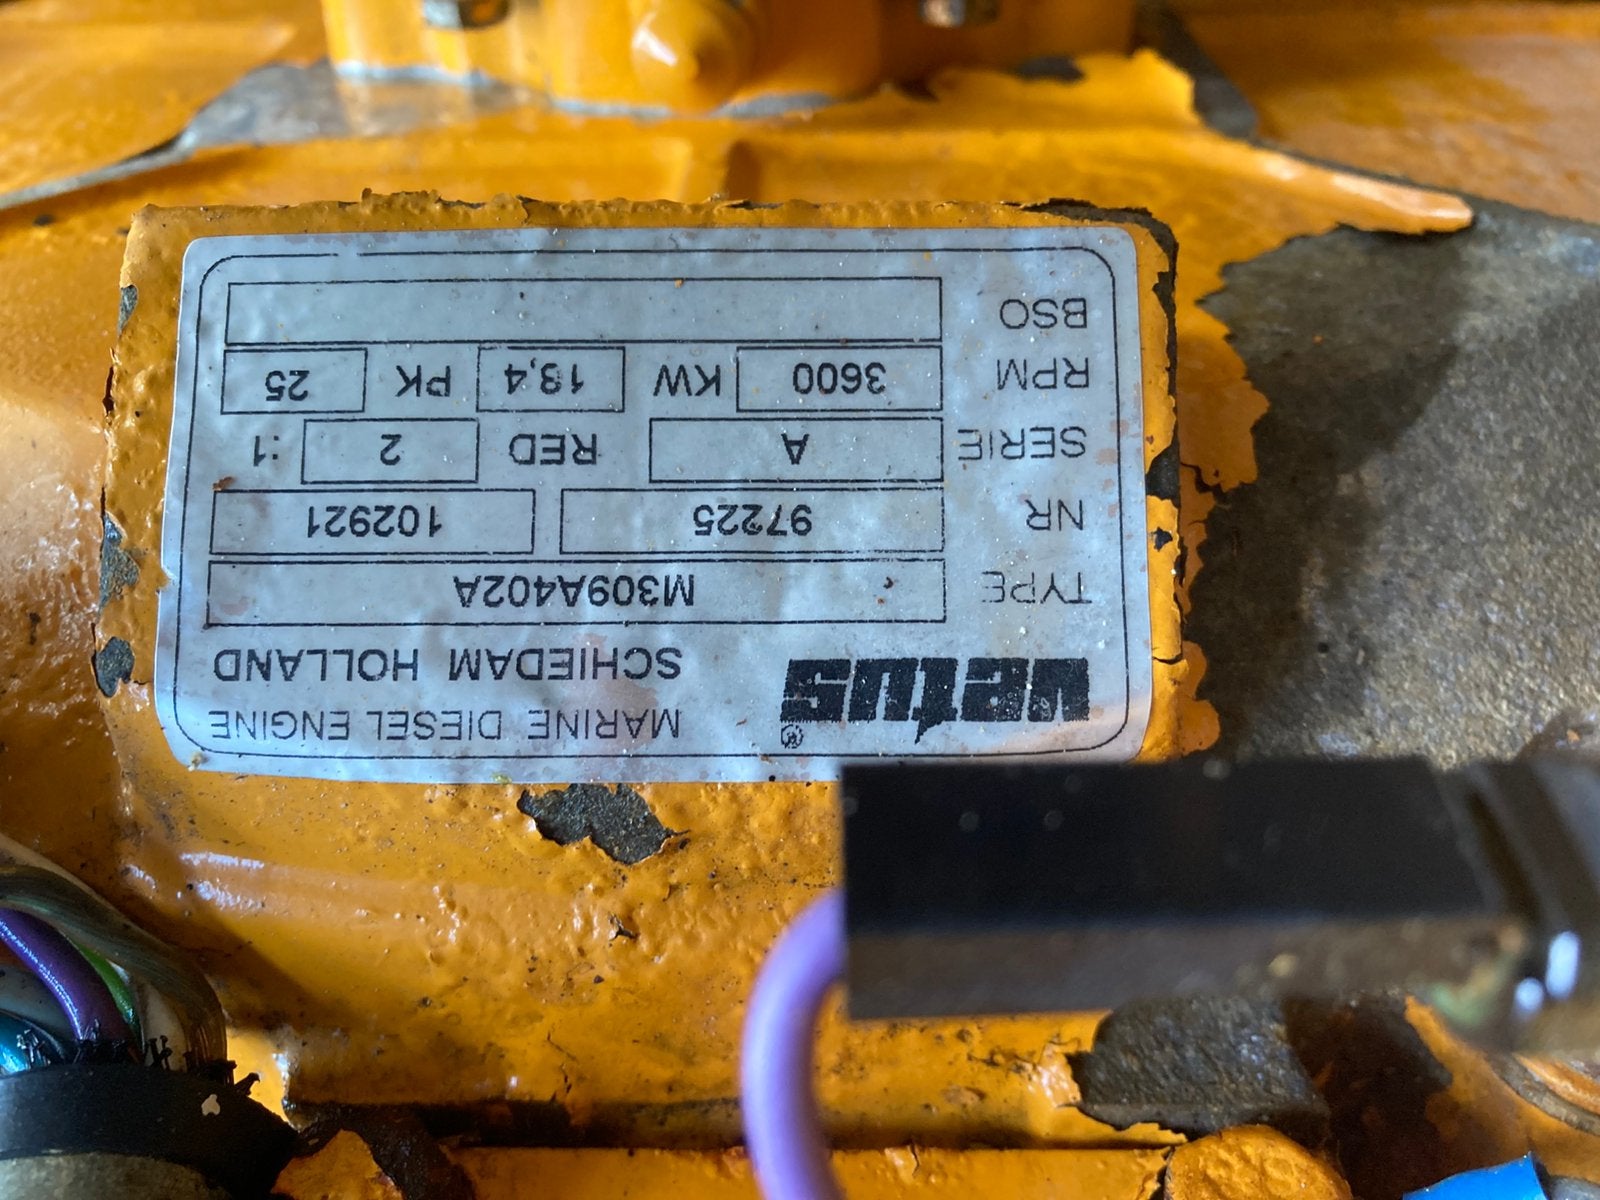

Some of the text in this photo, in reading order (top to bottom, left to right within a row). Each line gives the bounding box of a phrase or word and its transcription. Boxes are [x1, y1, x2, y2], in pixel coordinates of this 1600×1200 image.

[999, 298, 1088, 329] BSO
[264, 370, 309, 401] 25
[395, 365, 451, 397] PK
[653, 364, 721, 396] KW
[792, 361, 887, 395] 3600
[996, 358, 1089, 391] RPM
[253, 426, 1087, 467] SERIE A RED 2 :1
[307, 499, 1083, 537] NR 97225 102921
[452, 571, 1091, 607] TYPE M309A402A
[213, 647, 682, 682] SCHIEDAM HOLLAND
[208, 708, 681, 740] MARINE DIESEL ENGINE
